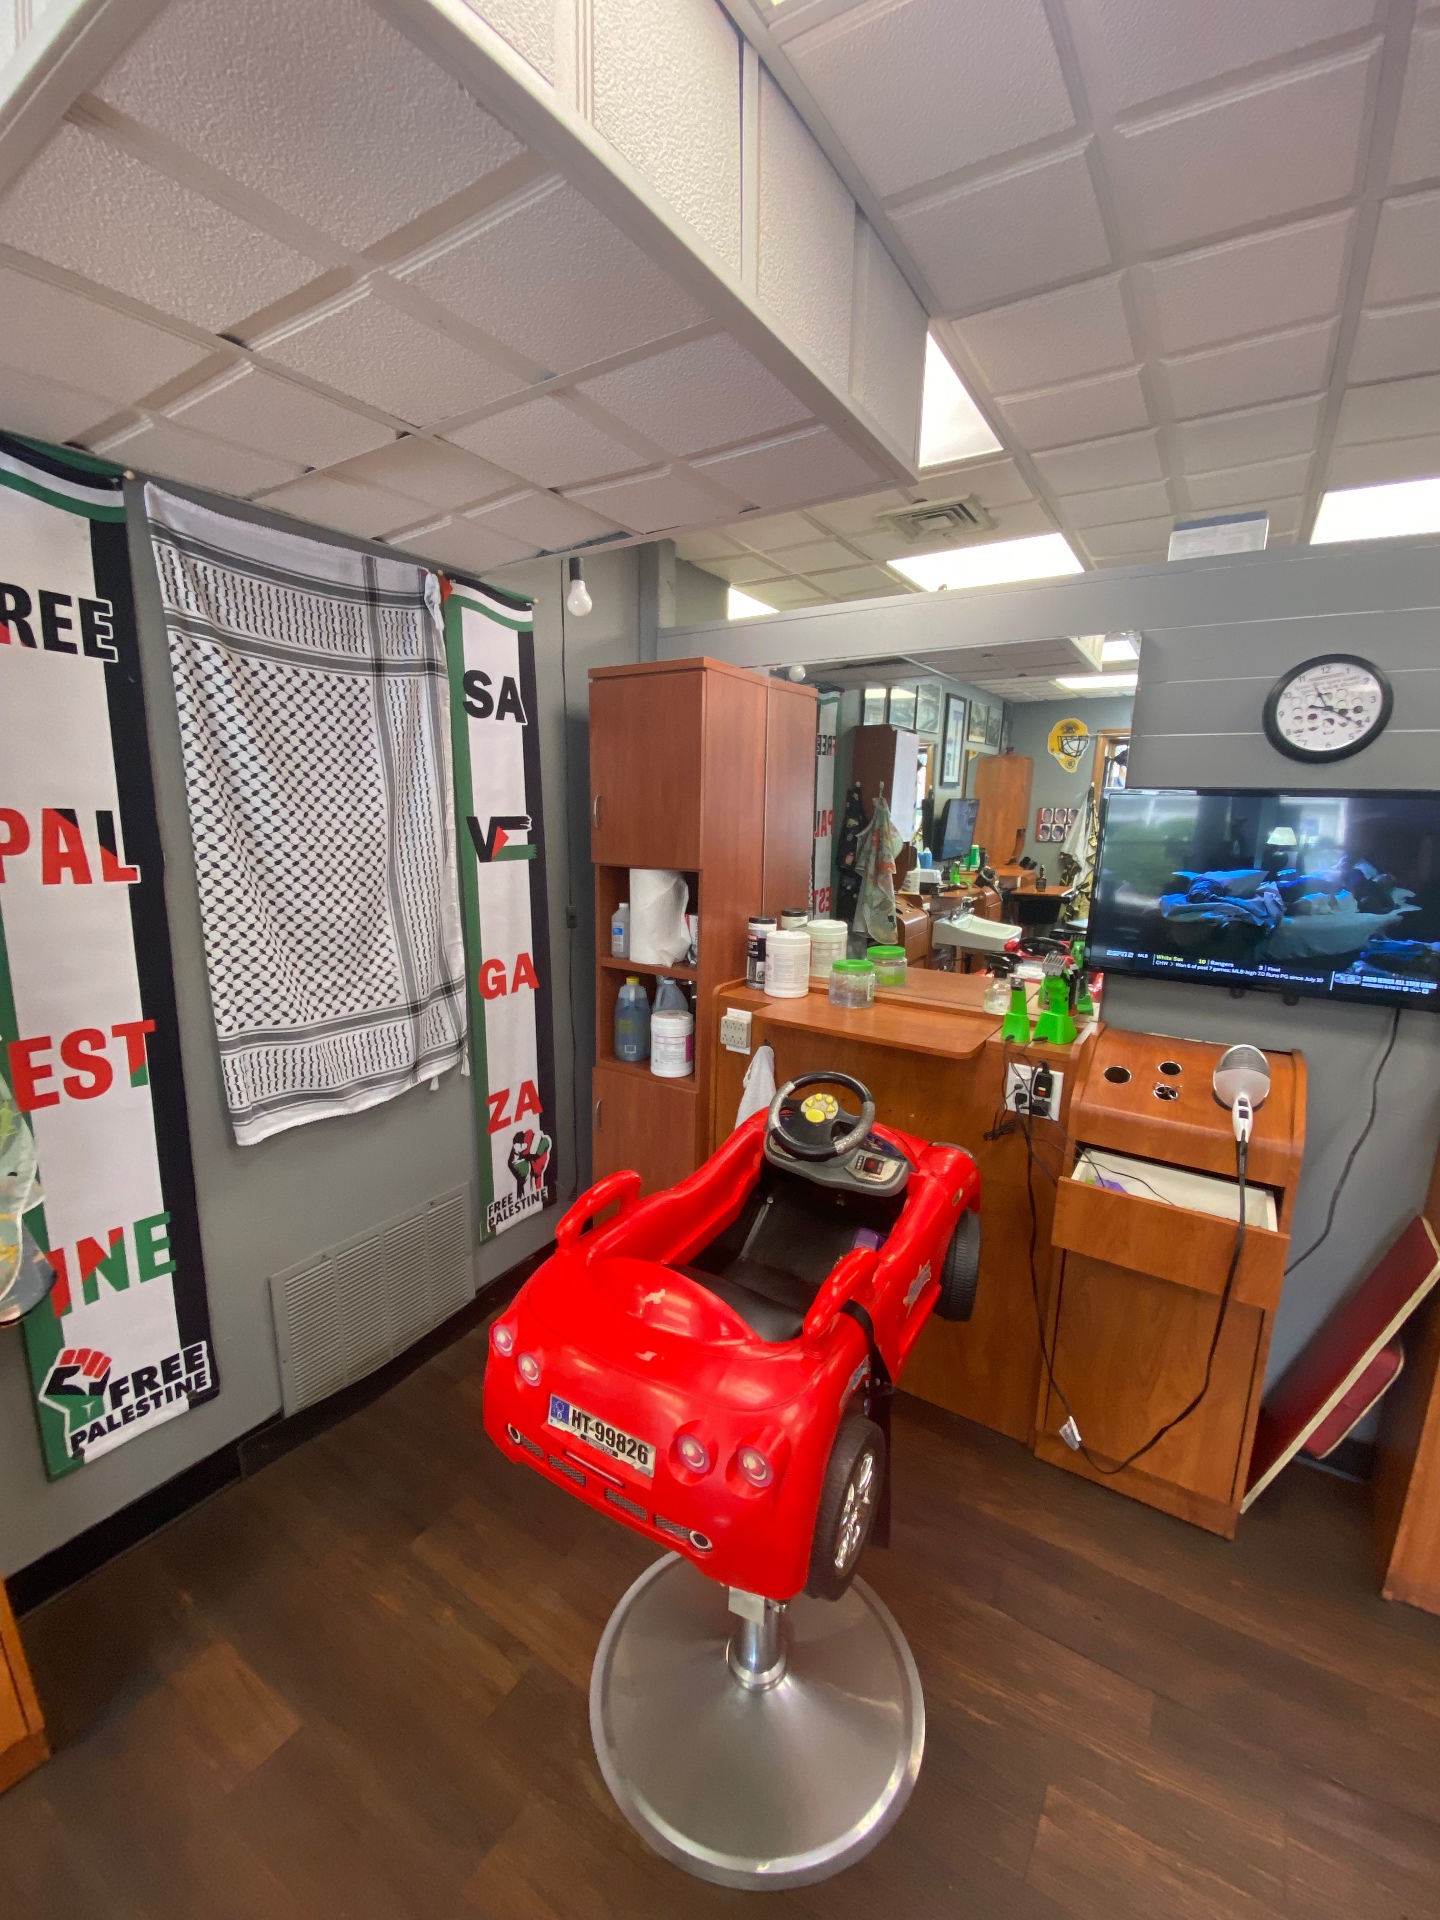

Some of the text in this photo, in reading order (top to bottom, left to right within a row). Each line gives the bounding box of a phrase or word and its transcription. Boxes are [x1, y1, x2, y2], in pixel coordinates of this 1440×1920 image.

[463, 669, 526, 723] SA
[1321, 666, 1331, 674] 12
[0, 808, 138, 884] PAL
[478, 952, 540, 1000] GA
[1210, 960, 1234, 968] Rangers
[8, 1019, 155, 1112] EST
[486, 1079, 544, 1135] ZA
[488, 1188, 546, 1227] PALESTINE
[489, 1192, 513, 1217] FREE
[46, 1212, 176, 1319] INE
[109, 1343, 205, 1410] FREE
[70, 1370, 207, 1452] PALESTINE
[572, 1409, 648, 1465] HT-99826
